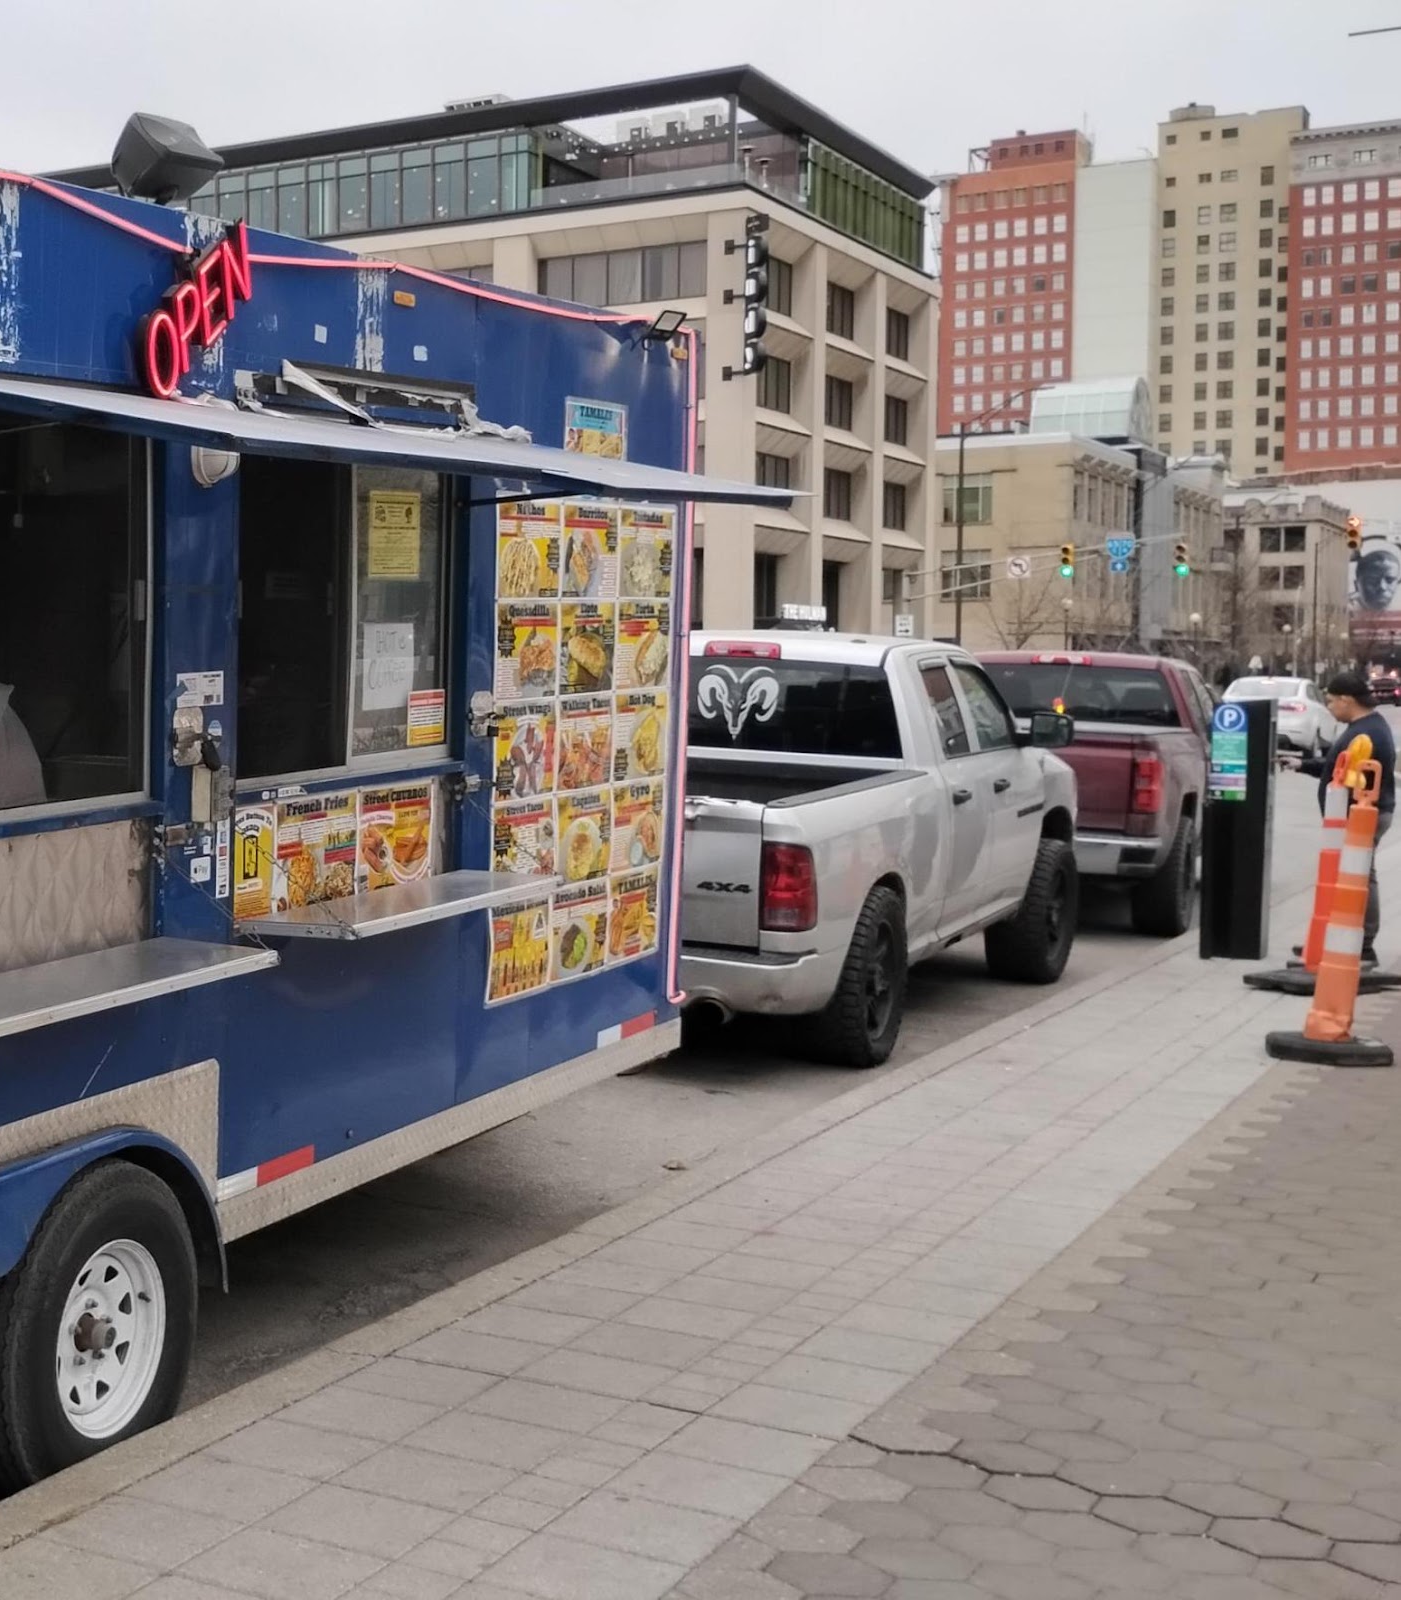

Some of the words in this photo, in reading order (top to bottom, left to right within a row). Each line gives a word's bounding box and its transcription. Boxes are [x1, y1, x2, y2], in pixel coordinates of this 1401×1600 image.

[147, 219, 252, 399] OPEN
[629, 694, 641, 706] Hot
[642, 693, 656, 707] Dog
[503, 705, 527, 718] Street
[1223, 708, 1238, 727] P
[363, 793, 390, 806] Street
[630, 784, 650, 800] Gyro
[286, 798, 323, 817] French
[323, 795, 349, 811] Fries
[555, 888, 587, 905] Avocado
